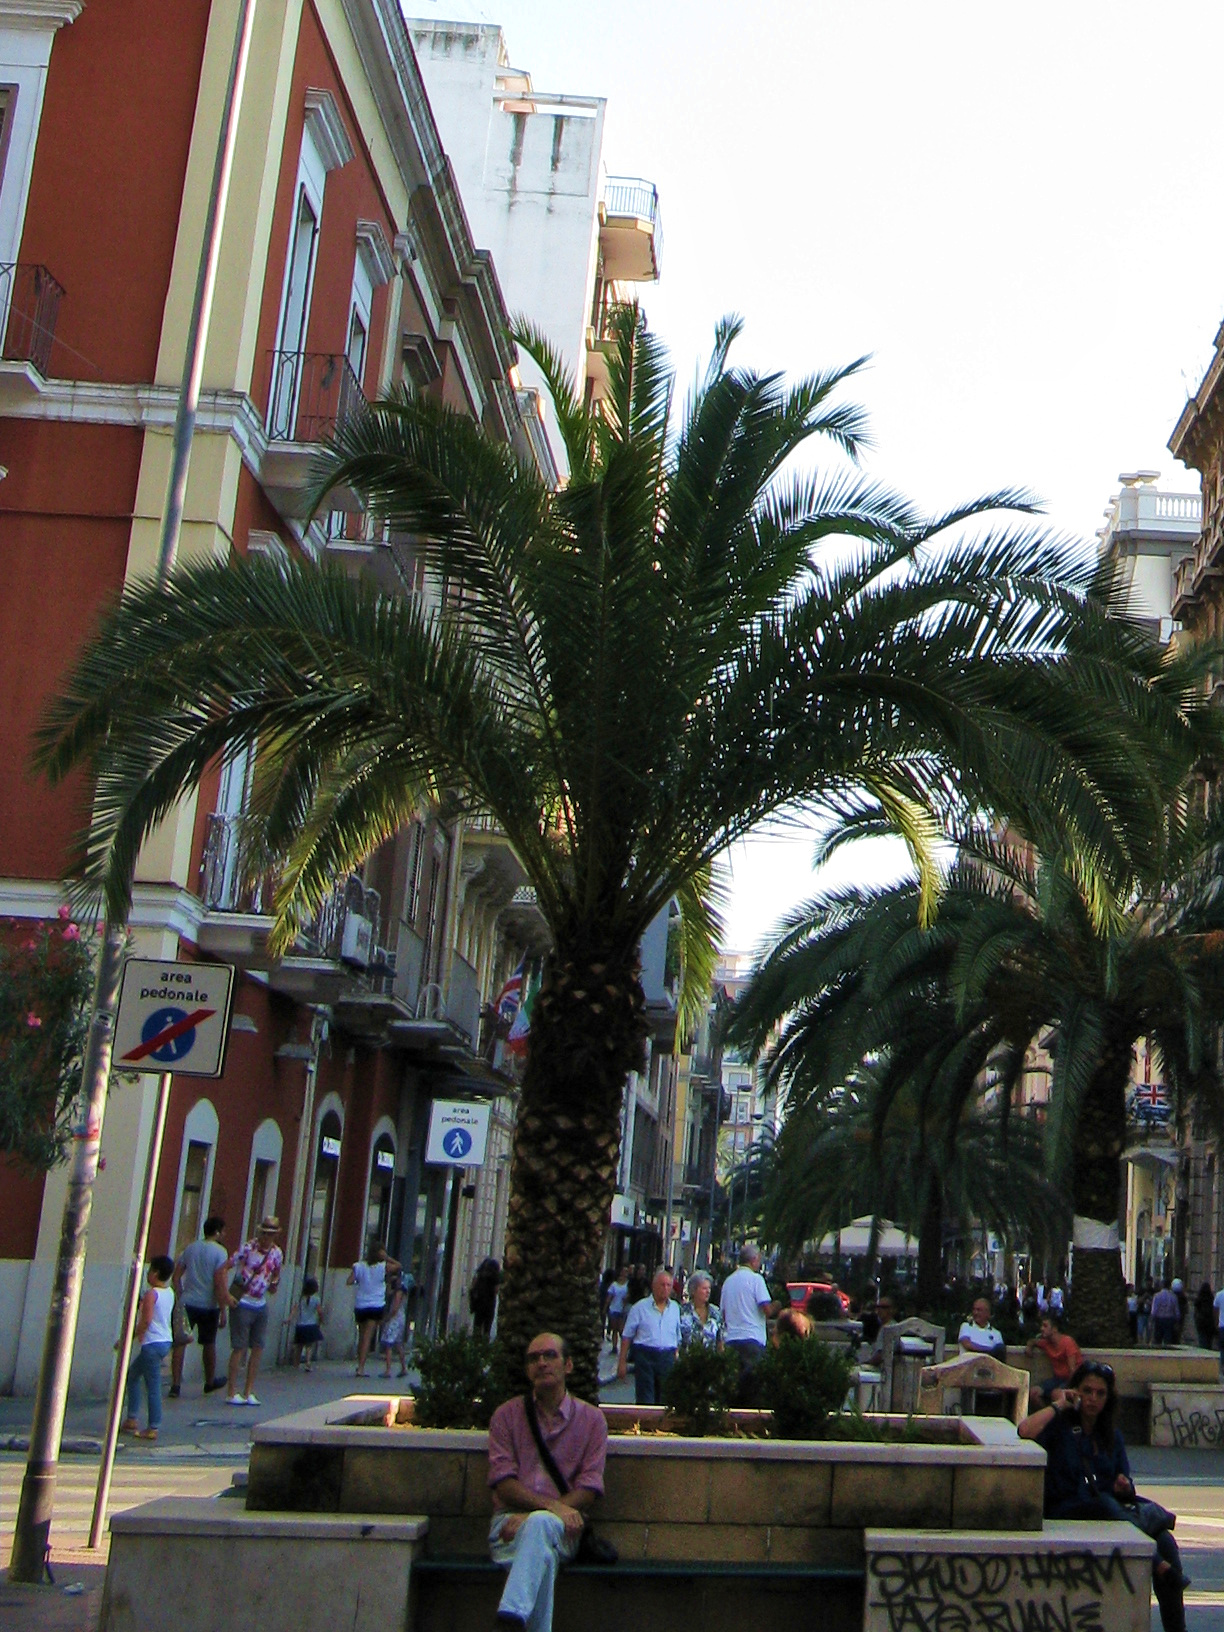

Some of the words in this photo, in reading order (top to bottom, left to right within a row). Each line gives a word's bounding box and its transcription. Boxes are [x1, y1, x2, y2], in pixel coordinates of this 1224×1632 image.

[160, 971, 192, 984] area
[140, 987, 209, 1002] pedonale
[452, 1107, 470, 1115] area
[441, 1116, 479, 1125] pedonale
